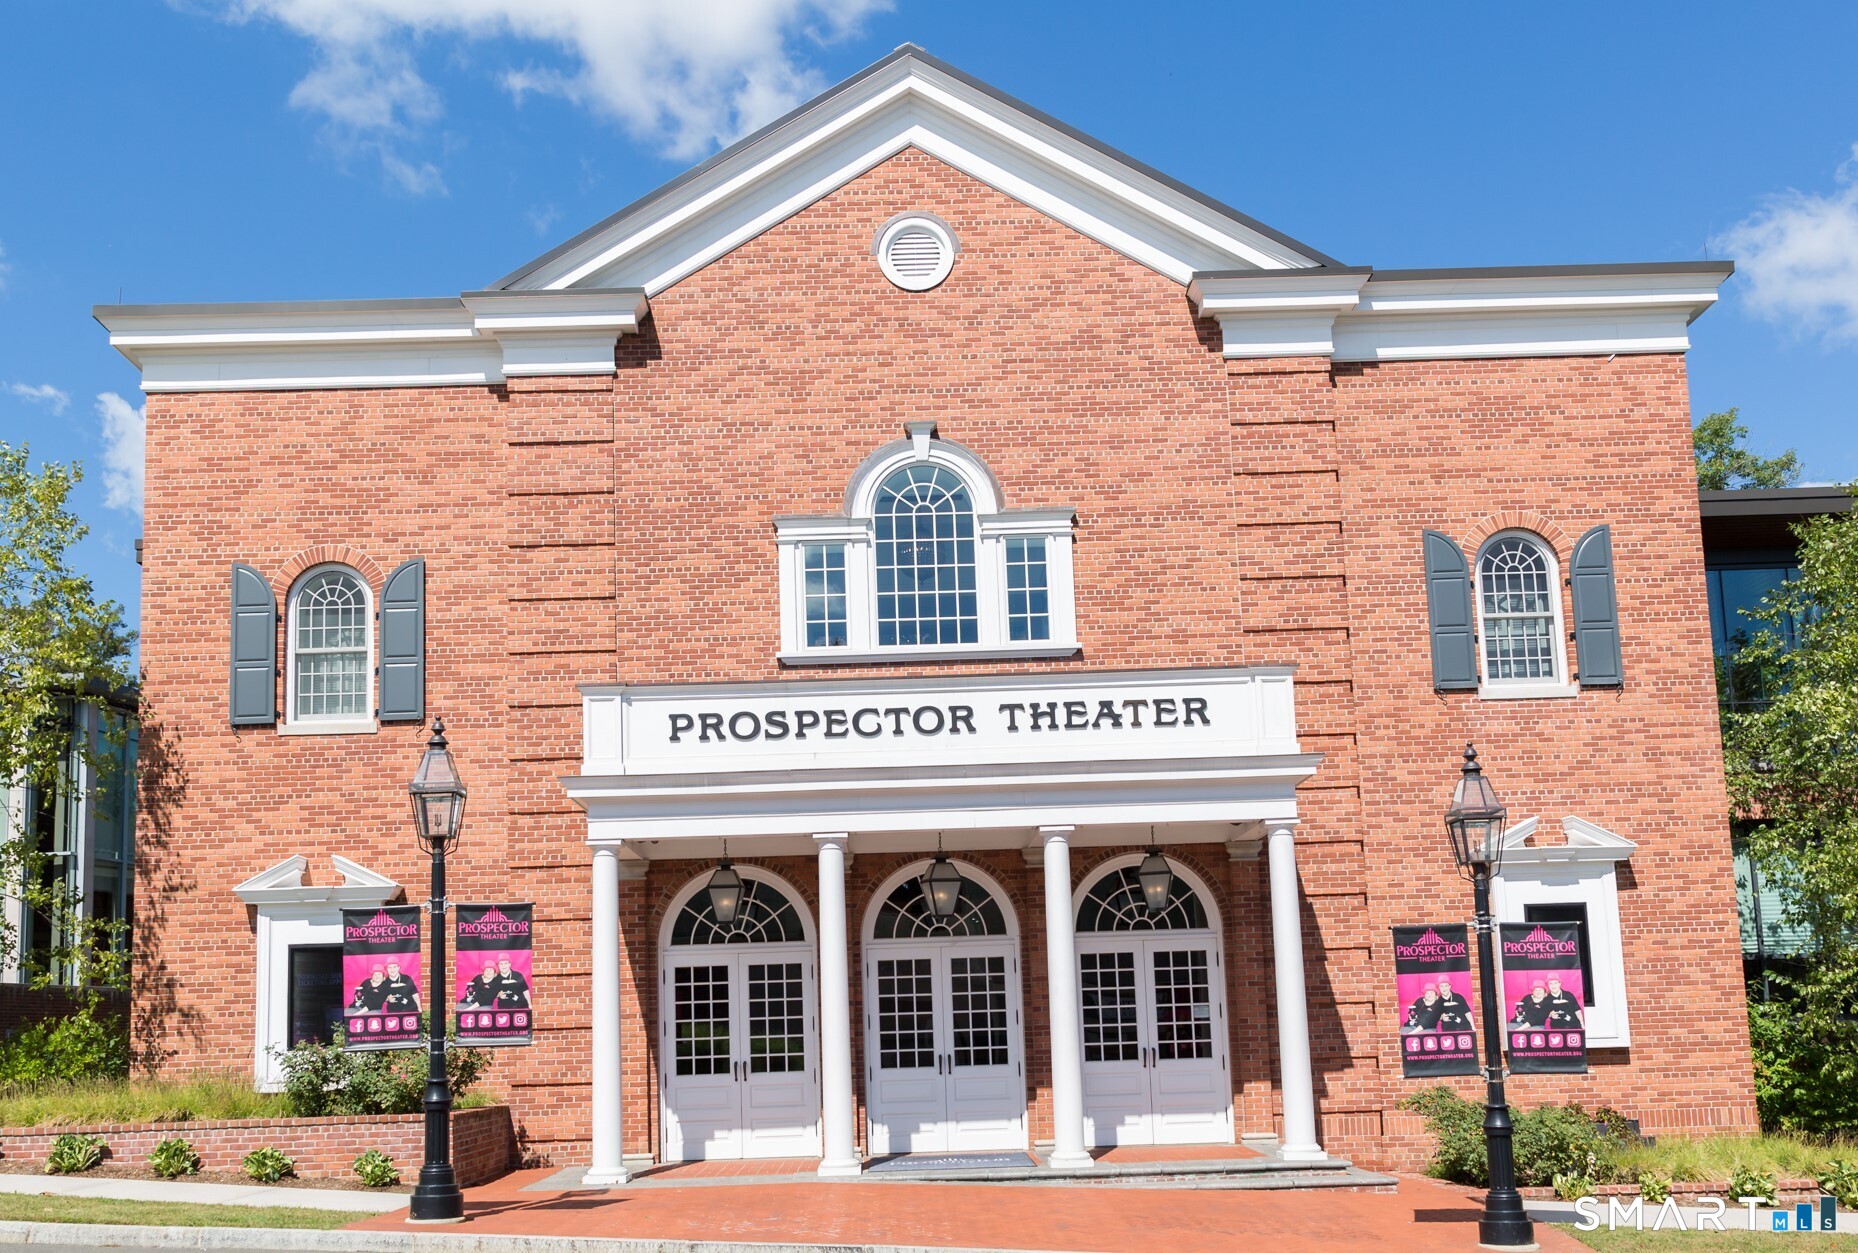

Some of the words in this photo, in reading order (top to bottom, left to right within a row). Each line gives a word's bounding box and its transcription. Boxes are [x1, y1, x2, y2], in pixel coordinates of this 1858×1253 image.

[668, 704, 977, 743] PROSPECTOR
[999, 697, 1212, 732] THEATER
[346, 924, 418, 938] PROSPECTOR
[458, 921, 529, 933] PROSPECTOR
[1396, 942, 1466, 956] PROSPECTOR
[1503, 941, 1576, 952] PROSPECTOR
